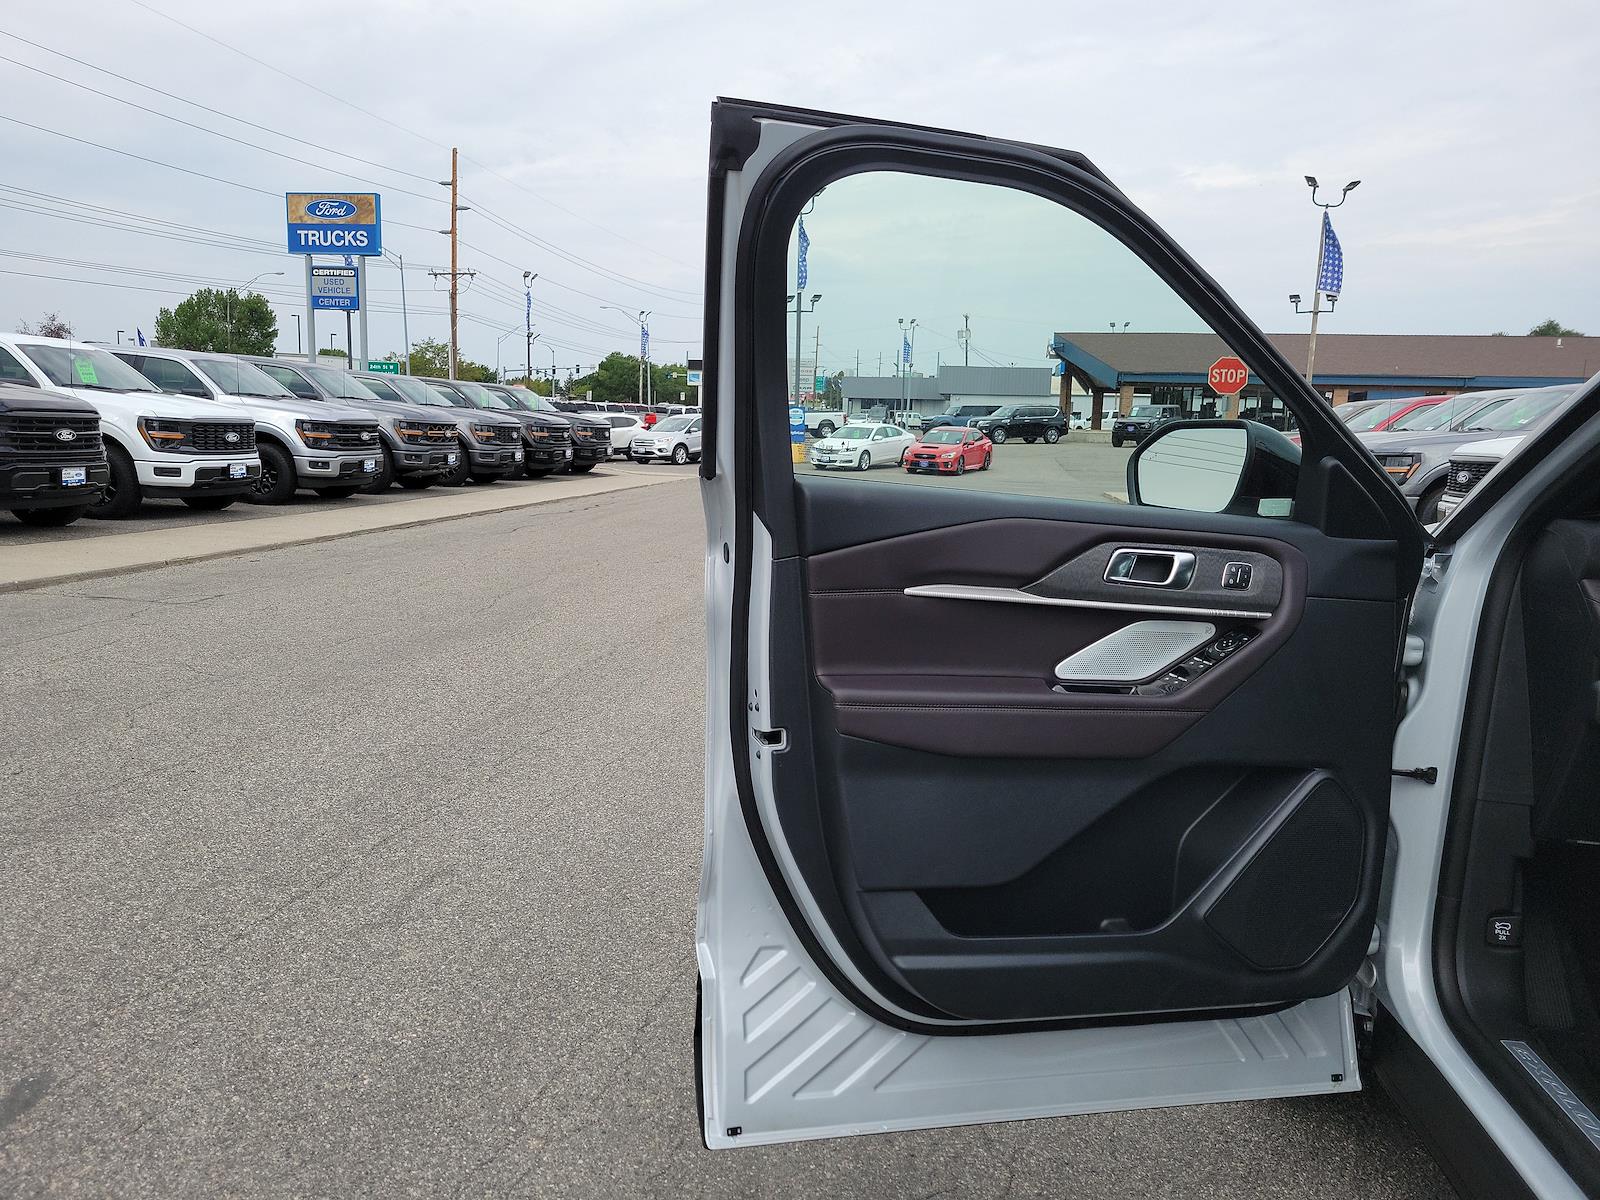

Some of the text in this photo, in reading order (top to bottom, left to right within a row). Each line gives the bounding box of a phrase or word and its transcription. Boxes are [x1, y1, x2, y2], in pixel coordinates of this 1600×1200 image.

[316, 201, 347, 216] Ford
[296, 230, 369, 247] TRUCKS
[312, 268, 355, 276] CERTIFIED
[323, 278, 345, 286] USED
[317, 286, 351, 295] VEHICLE
[318, 298, 351, 306] CENTER
[1211, 368, 1246, 383] STOP
